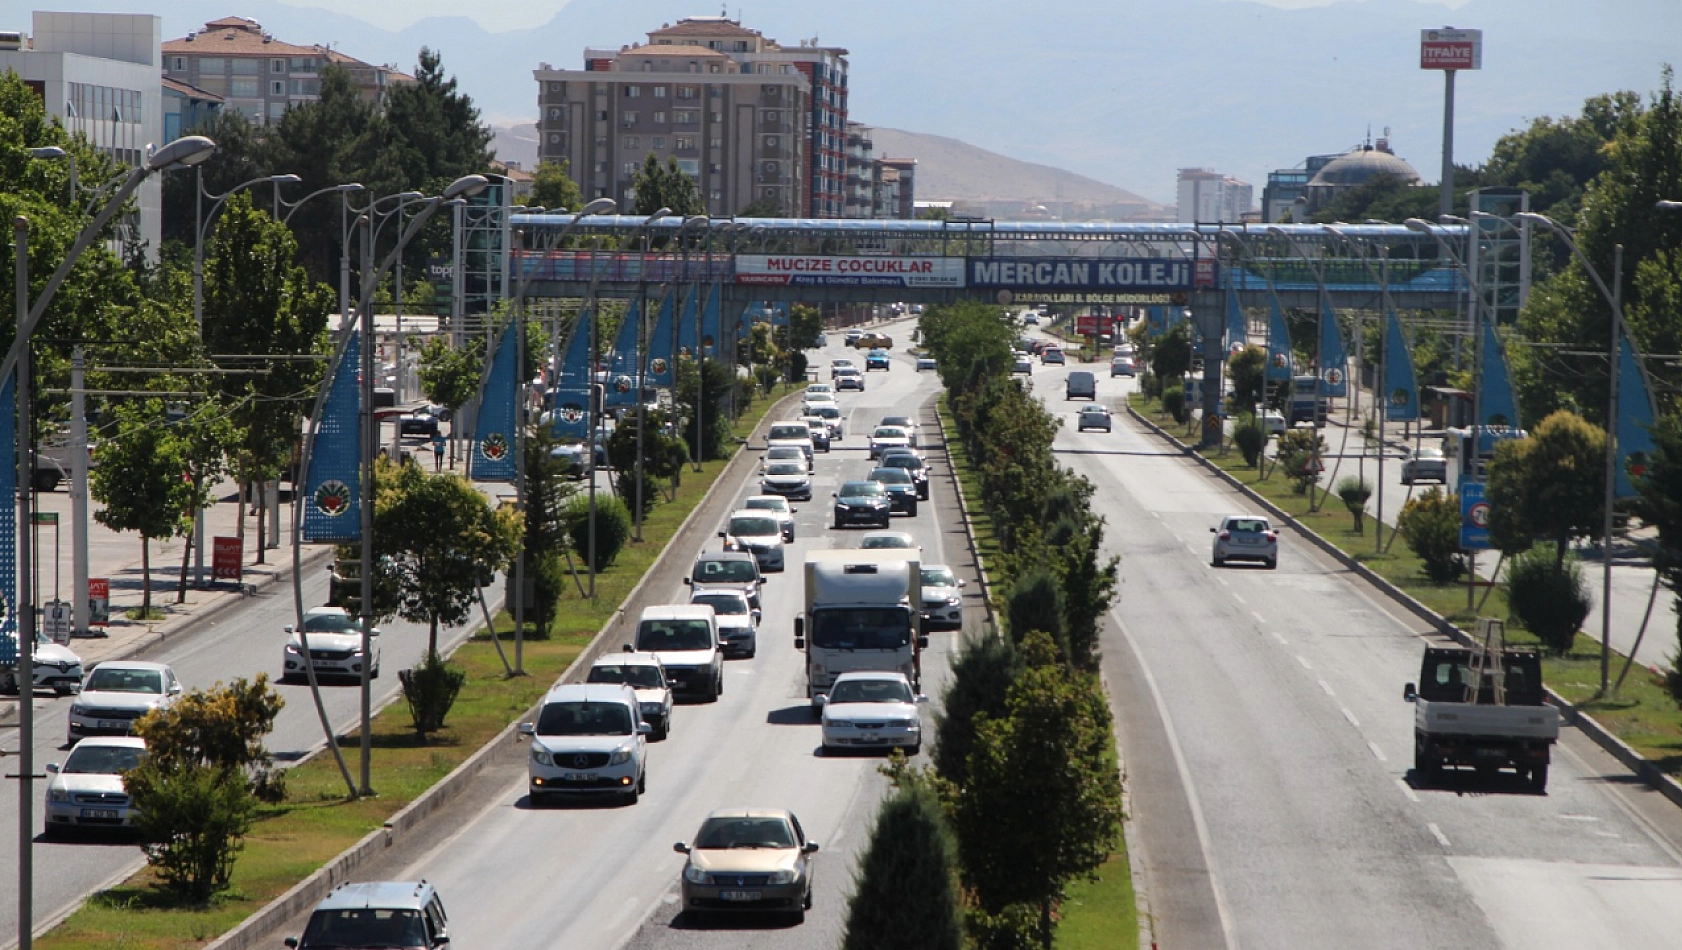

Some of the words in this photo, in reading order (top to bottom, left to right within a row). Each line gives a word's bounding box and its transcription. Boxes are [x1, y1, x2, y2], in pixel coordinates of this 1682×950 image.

[1423, 44, 1471, 58] İTFAİYE
[767, 258, 832, 271] MUCİZE
[837, 259, 933, 273] ÇOCUKLAR
[974, 261, 1089, 285] MERCAN
